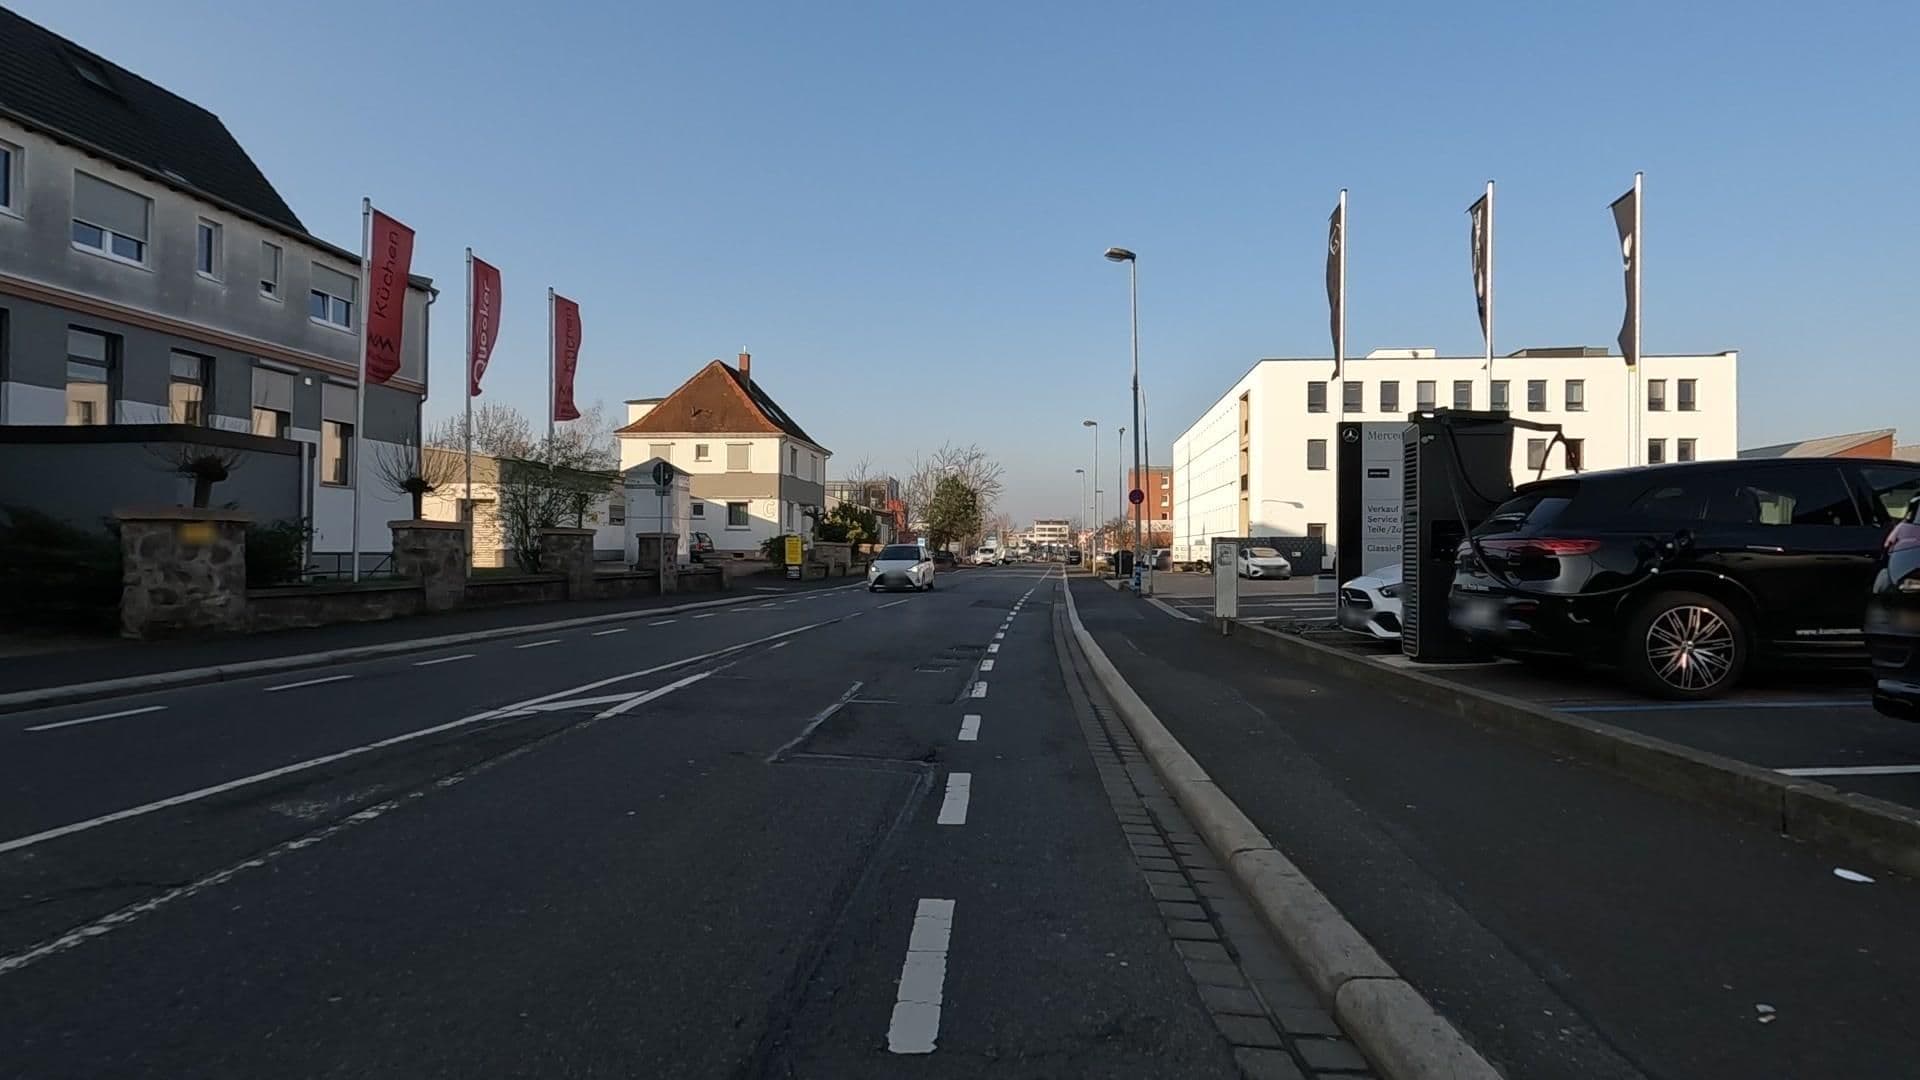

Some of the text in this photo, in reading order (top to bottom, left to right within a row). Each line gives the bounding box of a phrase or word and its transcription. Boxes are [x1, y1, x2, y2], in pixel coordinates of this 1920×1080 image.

[374, 231, 399, 318] Küchen
[1367, 505, 1399, 513] Verkauf
[1367, 515, 1398, 523] Service
